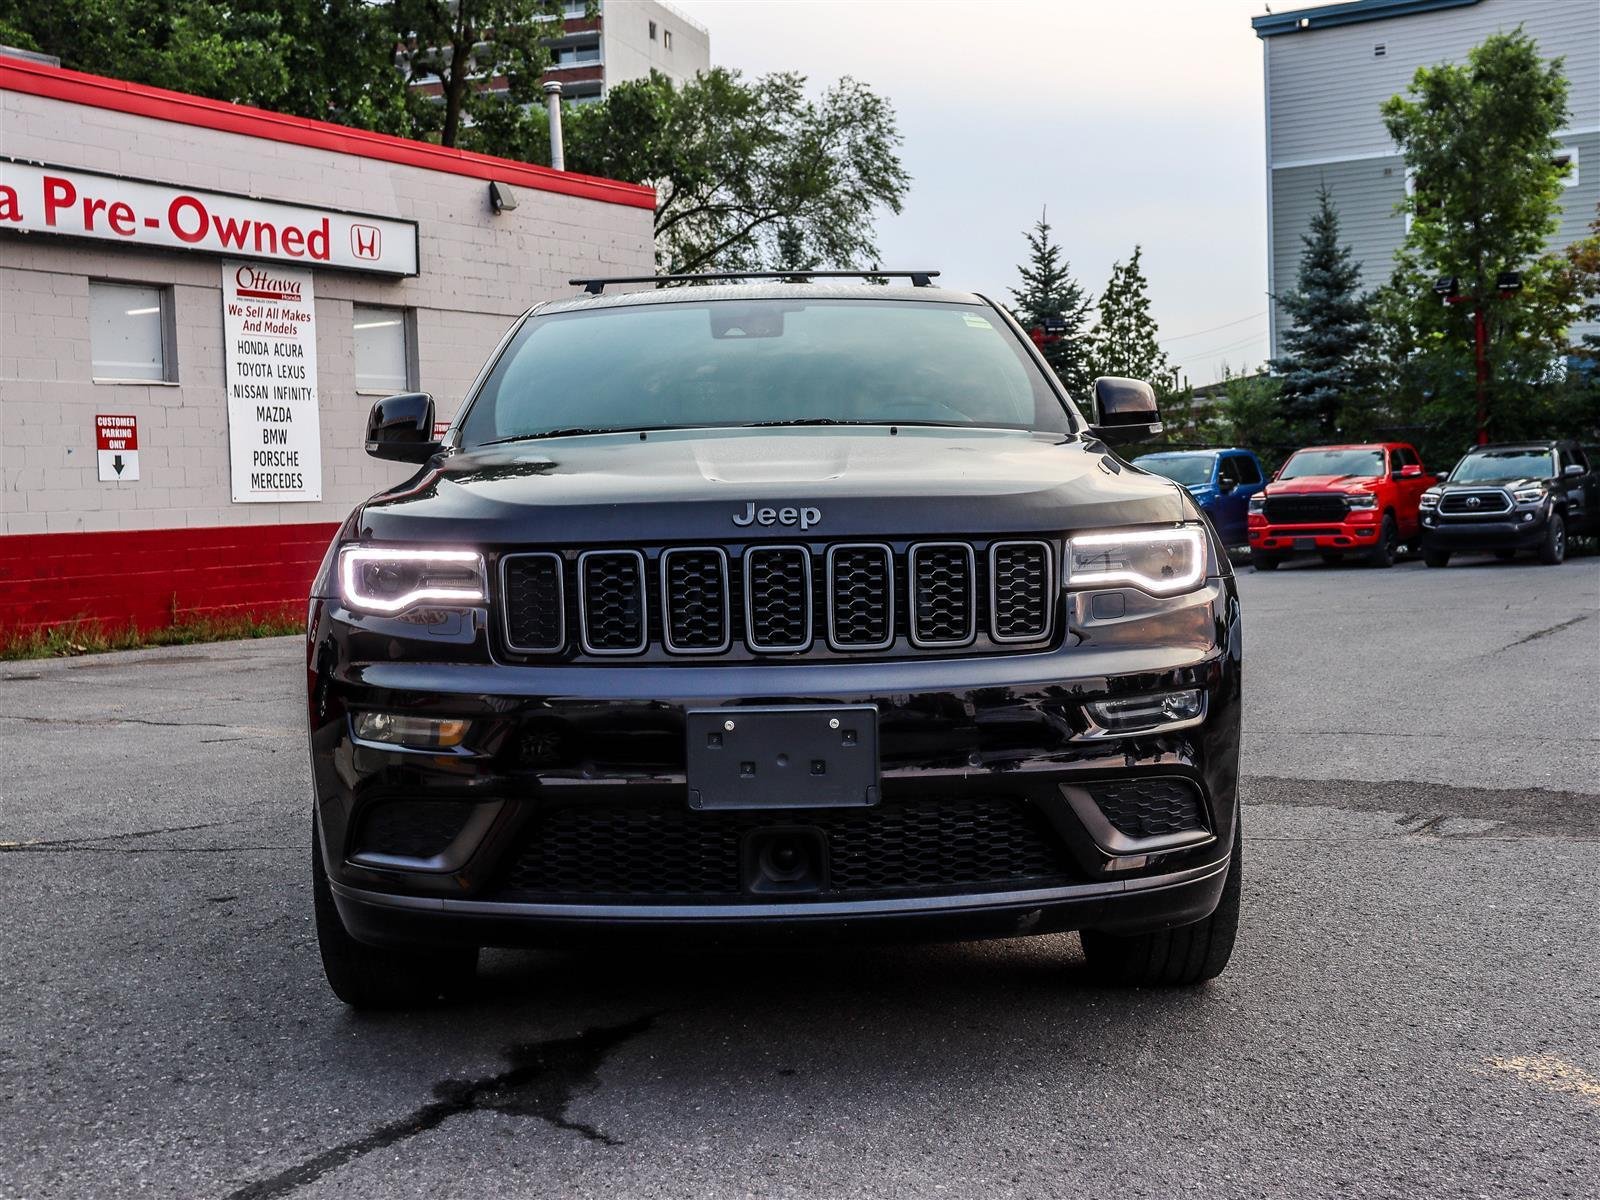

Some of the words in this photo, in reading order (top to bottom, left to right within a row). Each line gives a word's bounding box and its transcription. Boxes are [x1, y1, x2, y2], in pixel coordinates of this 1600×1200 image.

[43, 176, 331, 261] Pre-Owned
[236, 265, 302, 294] Ottawa
[228, 303, 243, 317] We
[246, 305, 264, 318] Sell
[266, 307, 279, 320] All
[281, 309, 312, 322] Makes
[243, 320, 262, 332] And
[264, 321, 298, 335] Models
[237, 340, 269, 356] HONDA
[273, 342, 304, 358] ACURA
[236, 361, 273, 378] TOYOTA
[277, 364, 306, 380] LEXUS
[233, 385, 269, 400] NISSAN
[273, 386, 312, 402] INFINITY
[97, 417, 135, 427] CUSTOMER
[256, 406, 292, 423] MAZDA
[101, 429, 132, 438] PARKING
[263, 428, 288, 445] BMW
[109, 440, 126, 449] ONLY
[253, 450, 299, 467] PORSCHE
[251, 472, 303, 489] MERCEDES
[732, 502, 822, 530] Jeep
